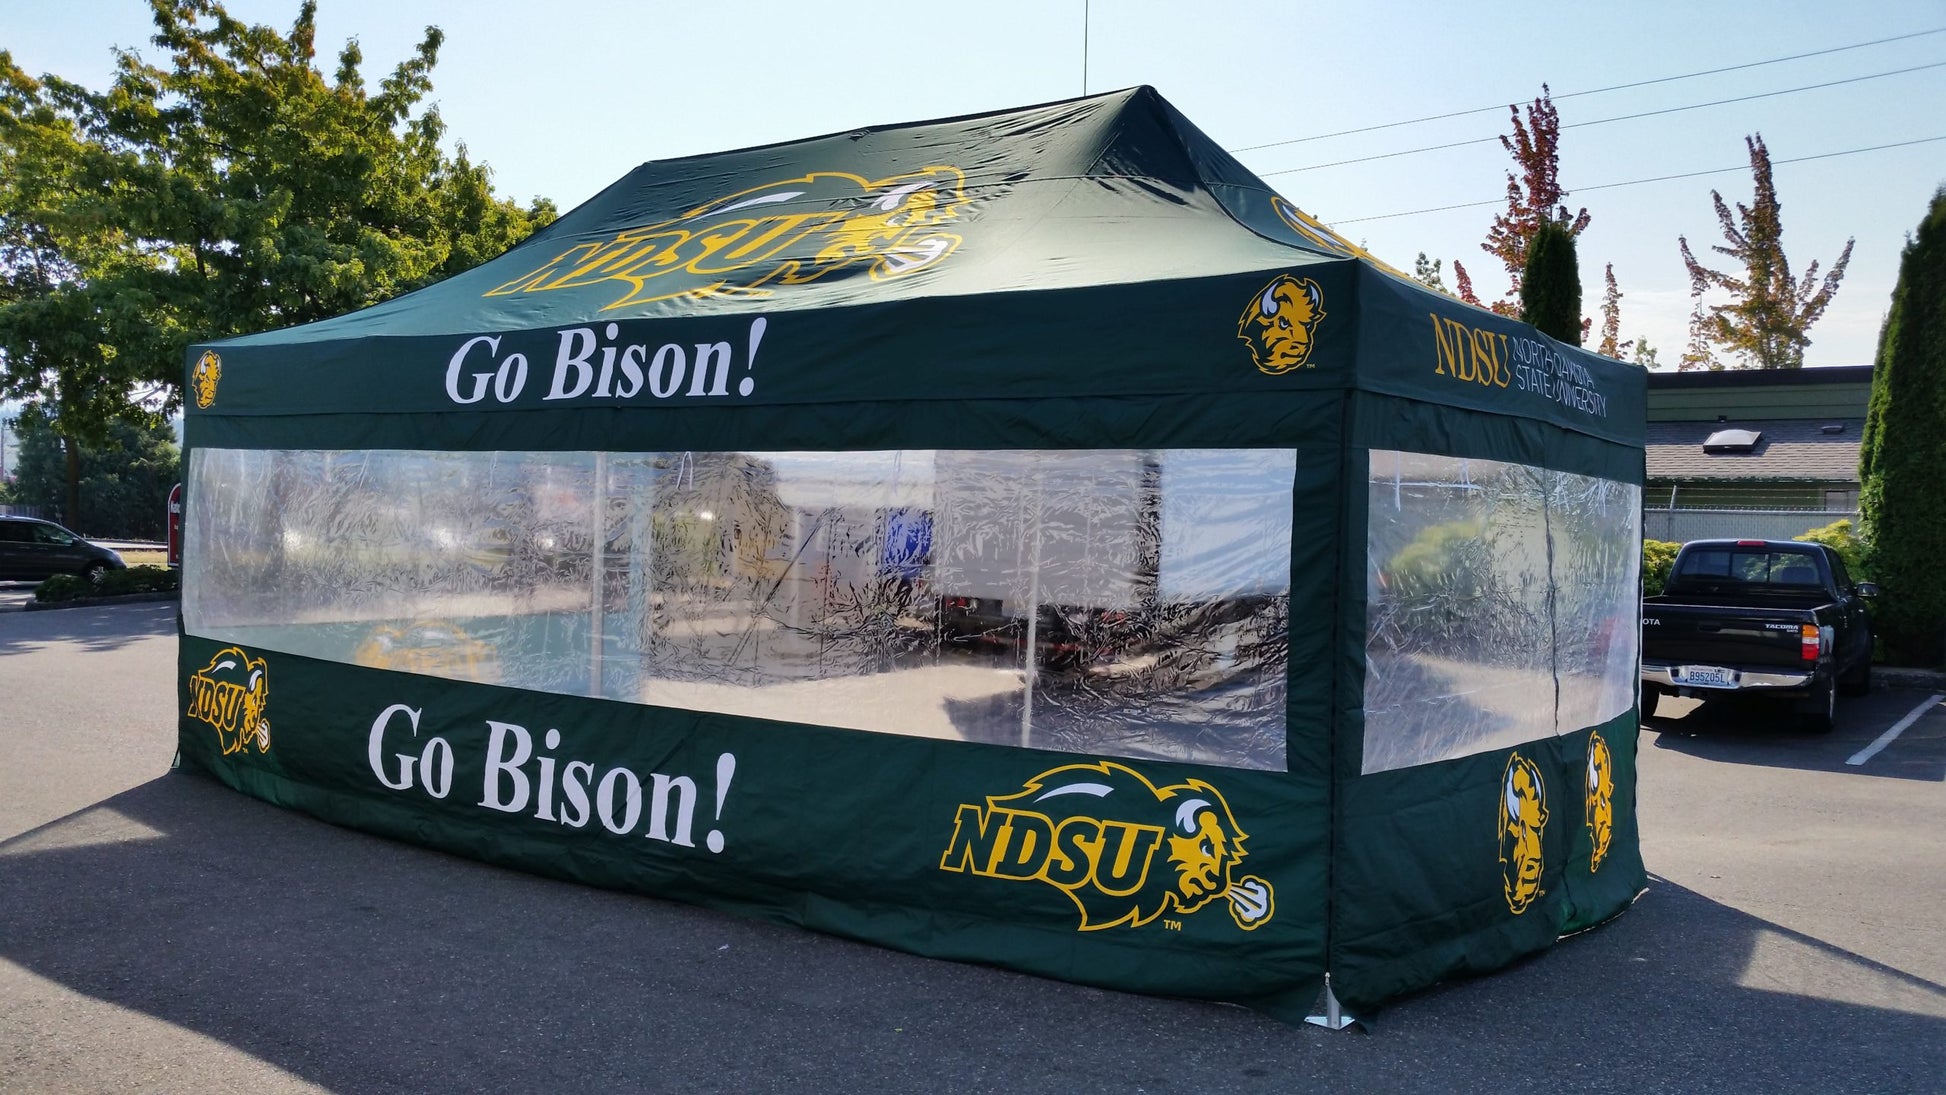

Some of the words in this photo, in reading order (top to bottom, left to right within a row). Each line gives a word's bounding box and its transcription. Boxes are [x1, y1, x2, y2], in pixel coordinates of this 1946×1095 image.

[446, 335, 528, 405] Go
[543, 317, 767, 400] Bison!
[1429, 313, 1511, 389] NDSU
[1512, 337, 1554, 374] NORTH
[1553, 352, 1595, 390] DAKOTA
[1515, 364, 1552, 399] STATE
[1552, 379, 1607, 418] UNIVERSITY
[1642, 617, 1661, 626] OTA
[187, 675, 247, 732] NDSU
[368, 703, 454, 799] Go
[477, 719, 737, 854] Bison!
[939, 803, 1166, 897] NDSU
[1163, 919, 1182, 931] TM
